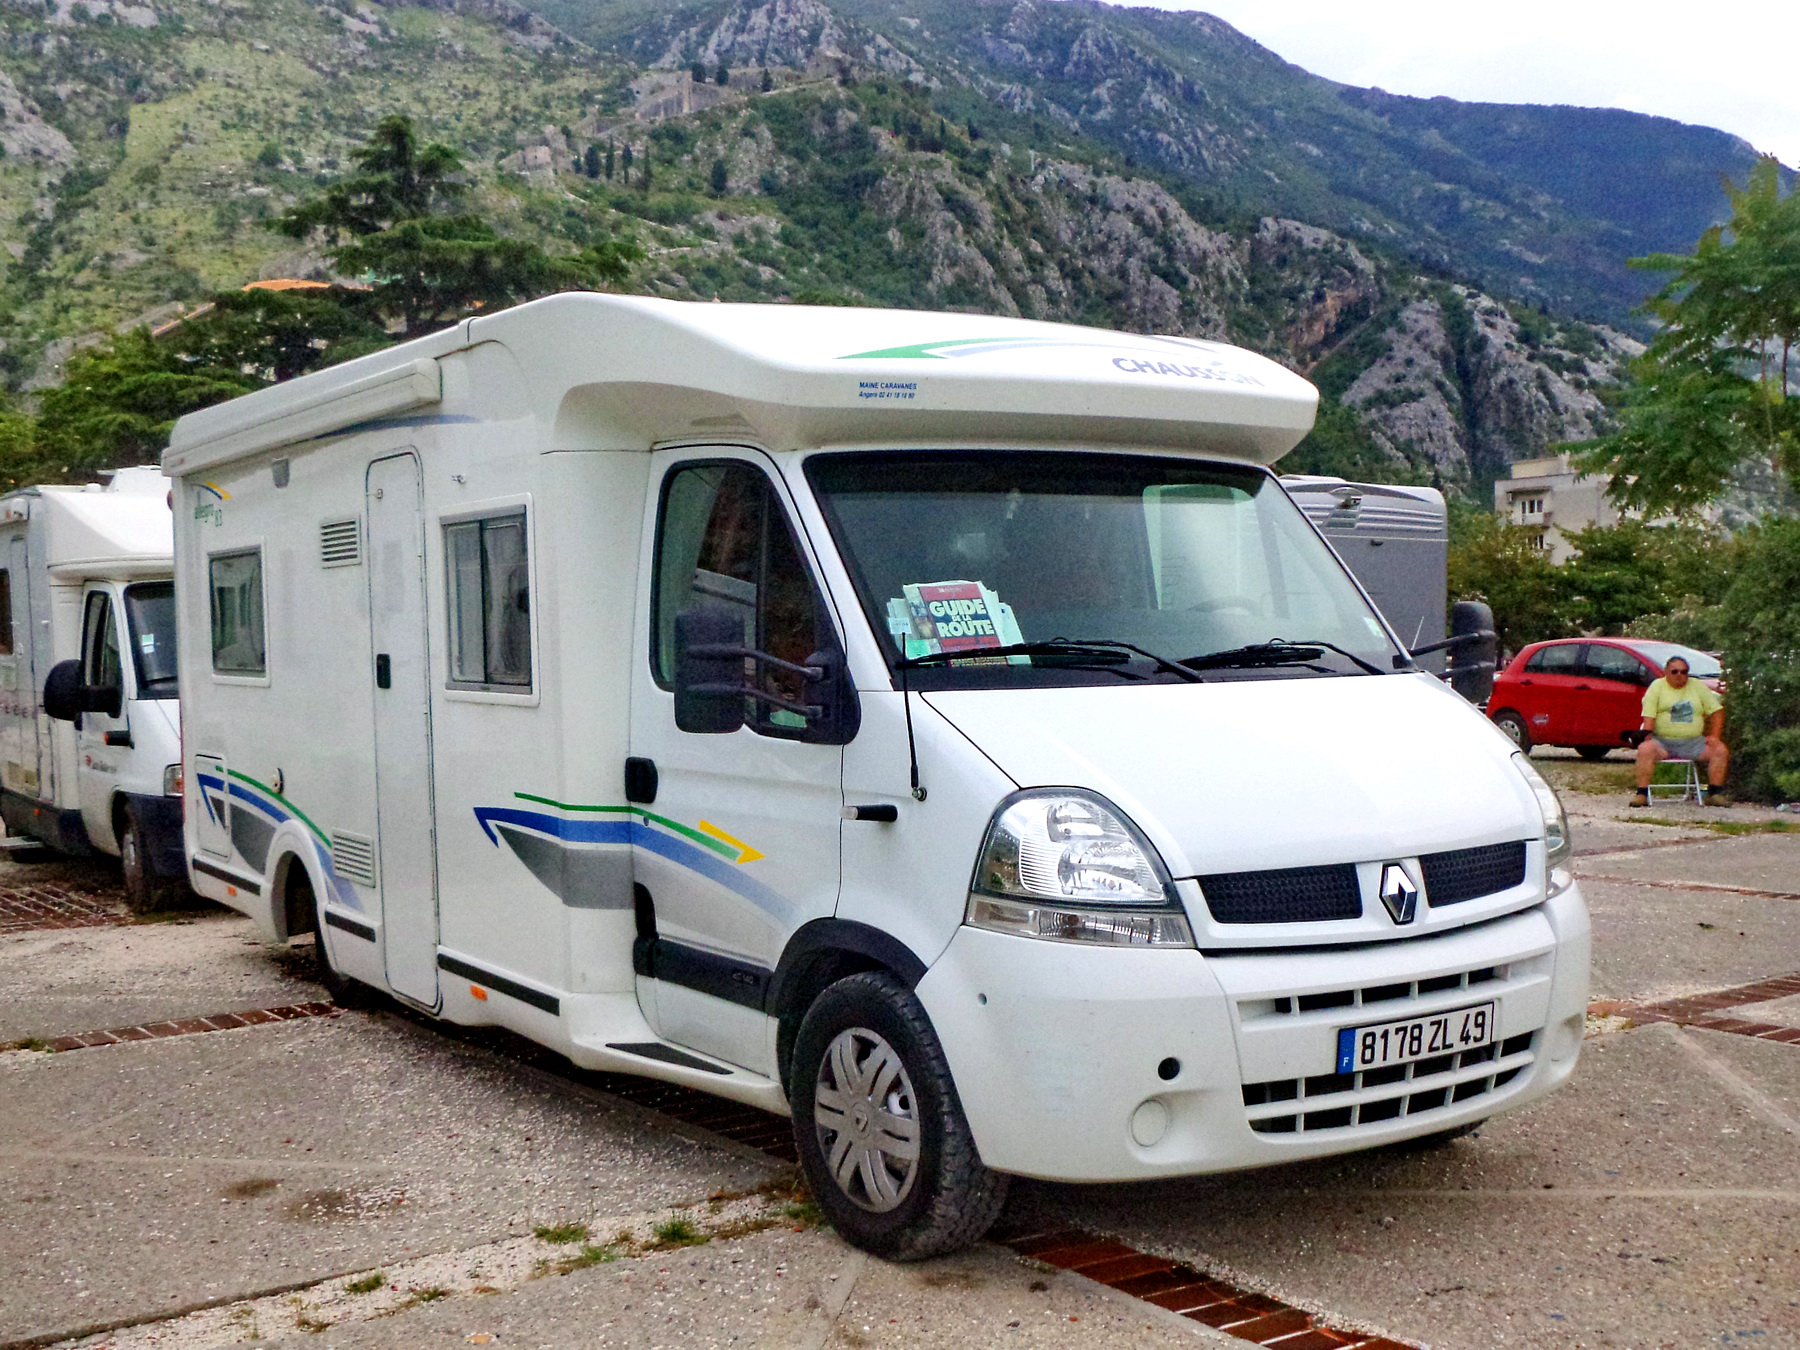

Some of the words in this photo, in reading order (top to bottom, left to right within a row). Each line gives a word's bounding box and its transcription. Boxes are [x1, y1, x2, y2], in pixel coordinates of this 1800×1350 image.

[880, 382, 917, 390] CARAVANES
[929, 598, 987, 617] GUIDE
[935, 620, 995, 638] ROUTE
[1361, 1023, 1423, 1064] 8178
[1428, 1018, 1454, 1052] ZL
[1459, 1010, 1487, 1045] 49
[1343, 1056, 1349, 1067] F
